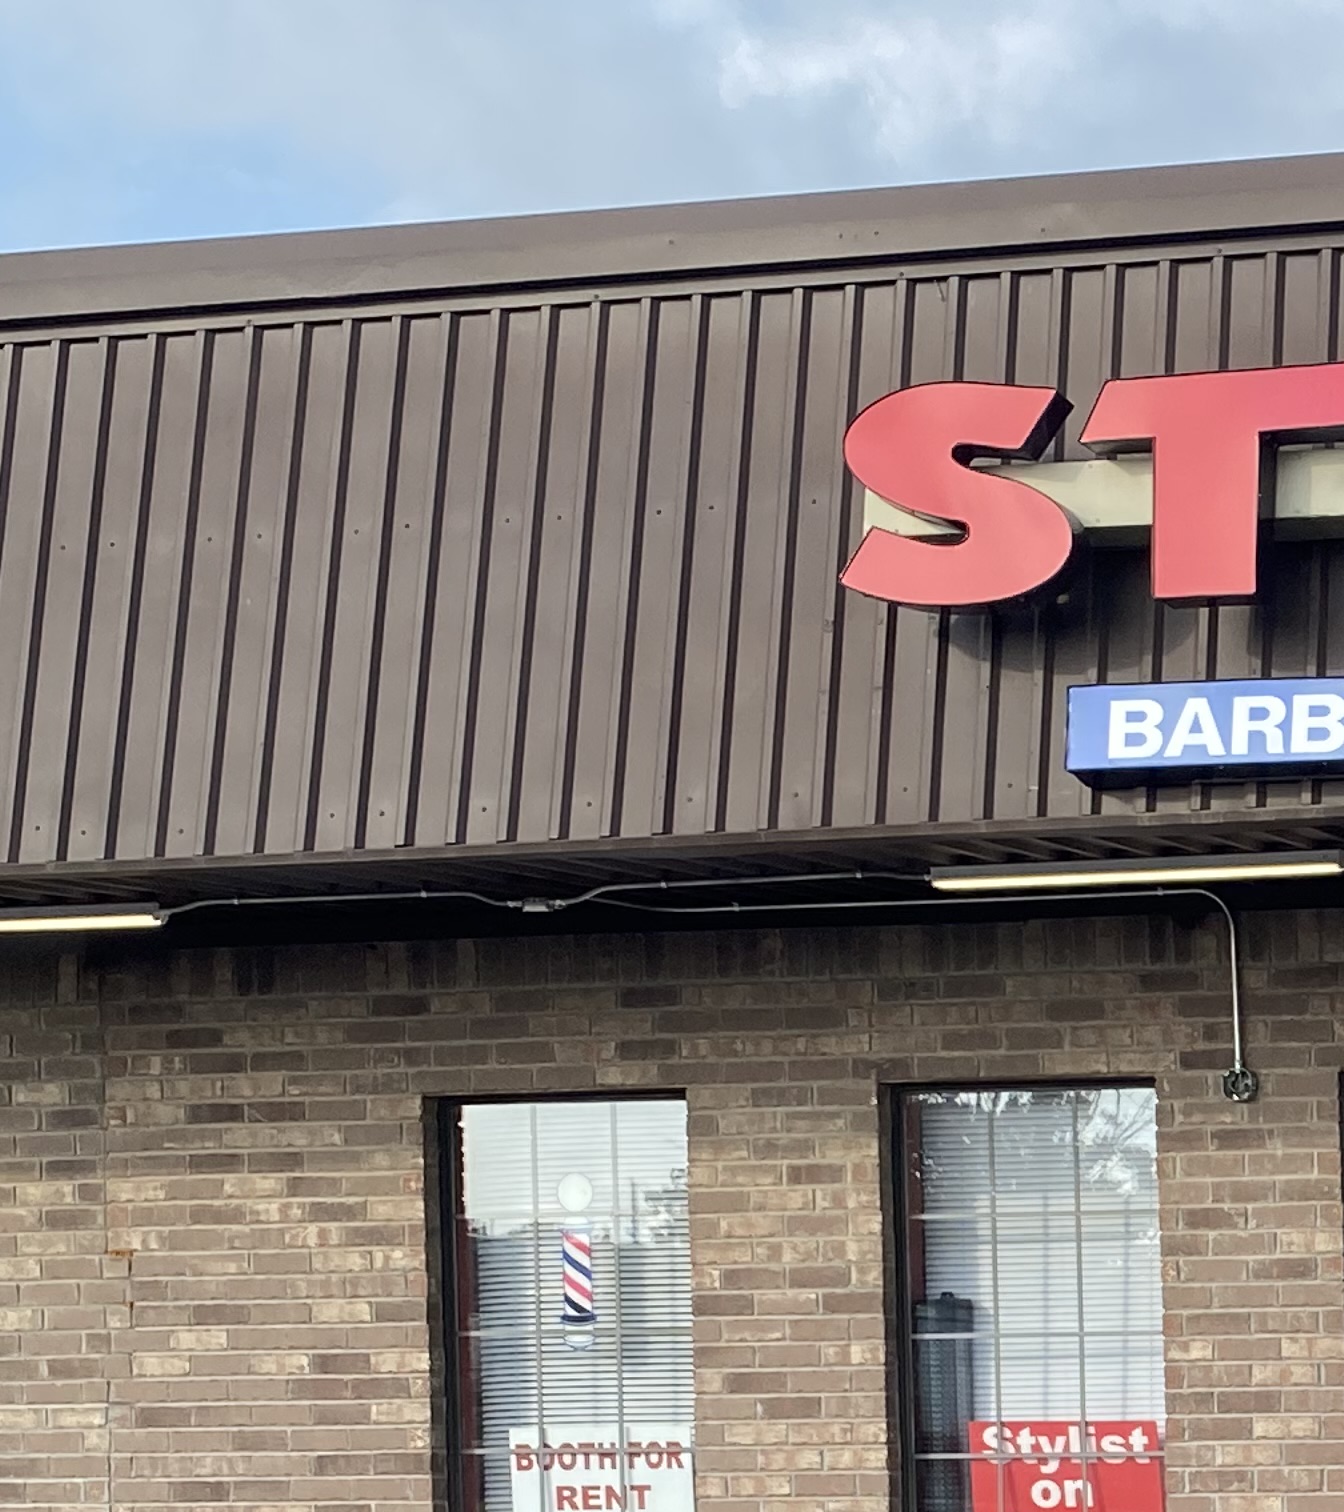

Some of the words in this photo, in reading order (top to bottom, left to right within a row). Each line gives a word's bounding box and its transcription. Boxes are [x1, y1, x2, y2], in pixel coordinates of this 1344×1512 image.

[514, 1442, 617, 1471] BOOTH
[627, 1441, 684, 1469] FOR
[982, 1425, 1151, 1474] Stylist
[556, 1484, 652, 1511] RENT
[1031, 1479, 1094, 1509] on
